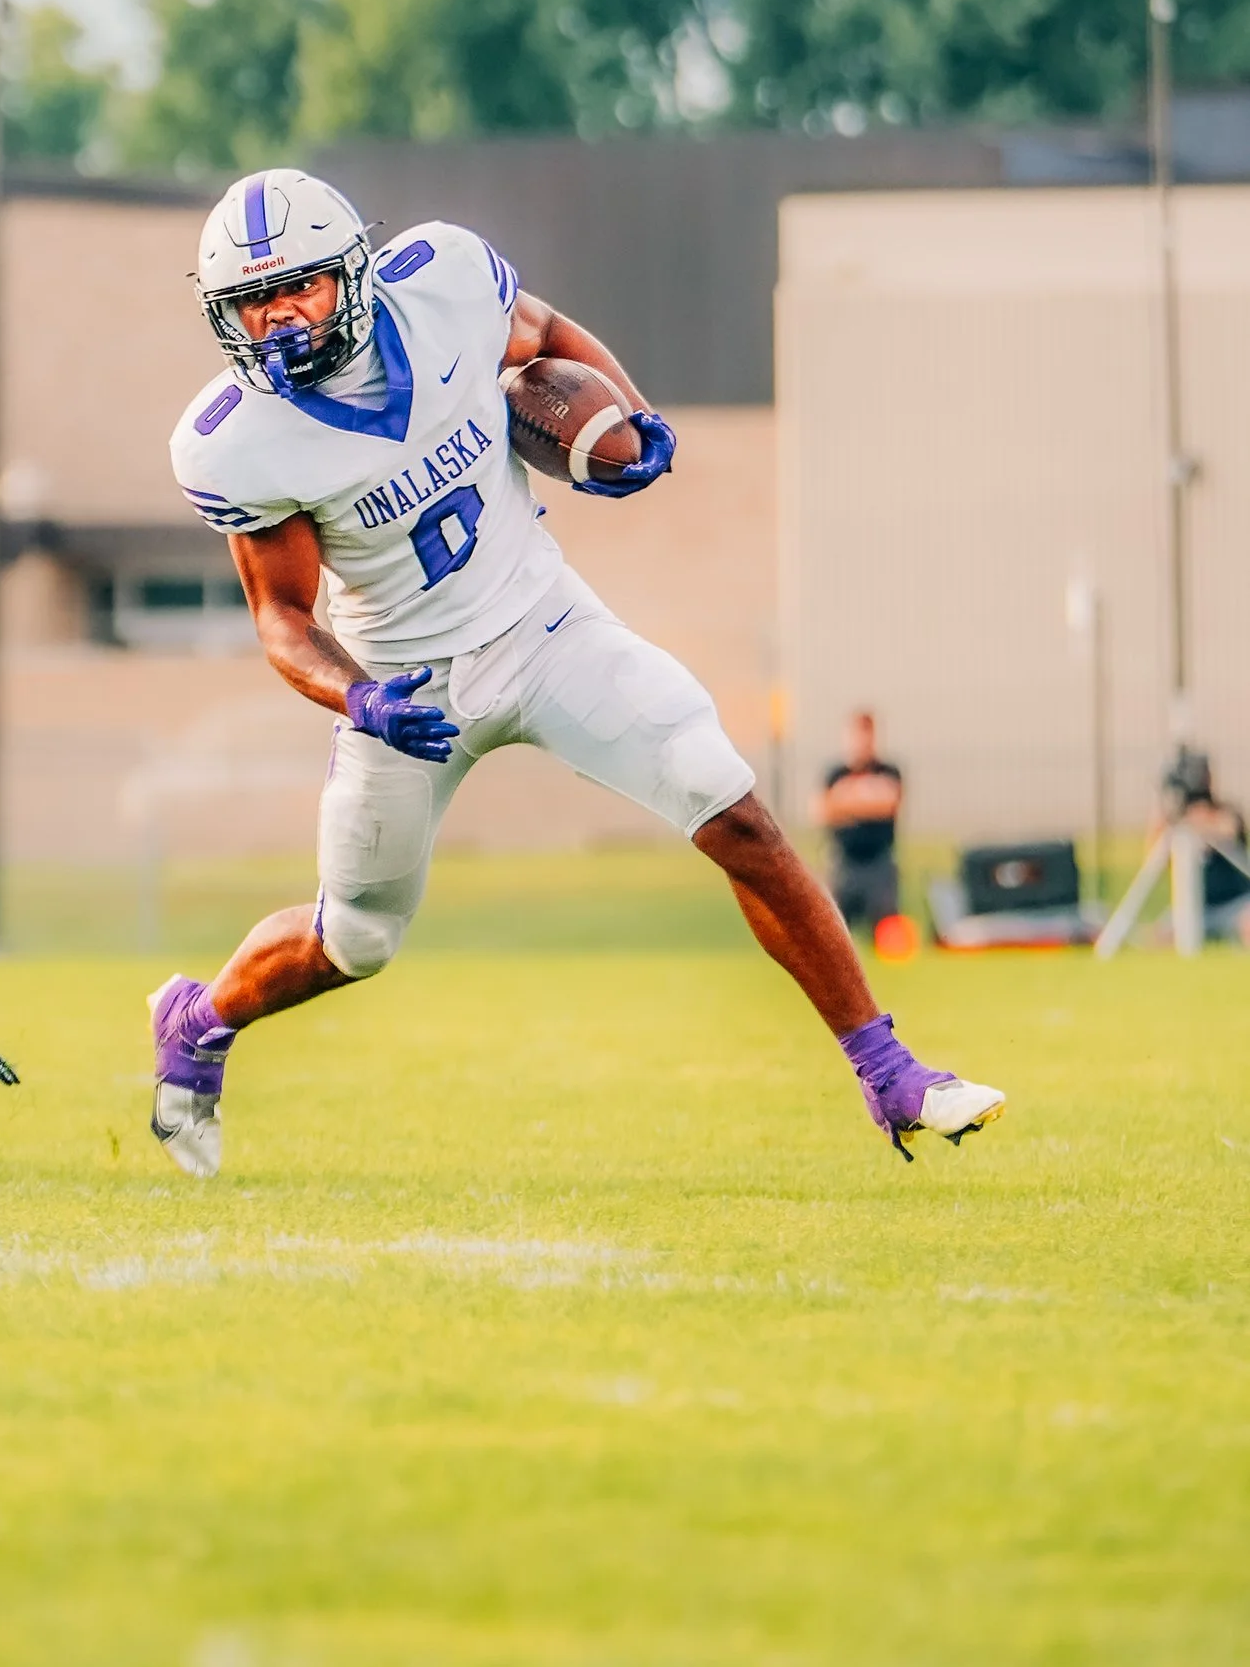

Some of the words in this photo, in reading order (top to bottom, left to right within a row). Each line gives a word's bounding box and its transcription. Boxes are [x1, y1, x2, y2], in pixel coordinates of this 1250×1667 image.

[242, 256, 285, 275] Riddell
[378, 240, 435, 283] 0
[194, 384, 243, 435] 0
[354, 419, 493, 529] UNALASKA
